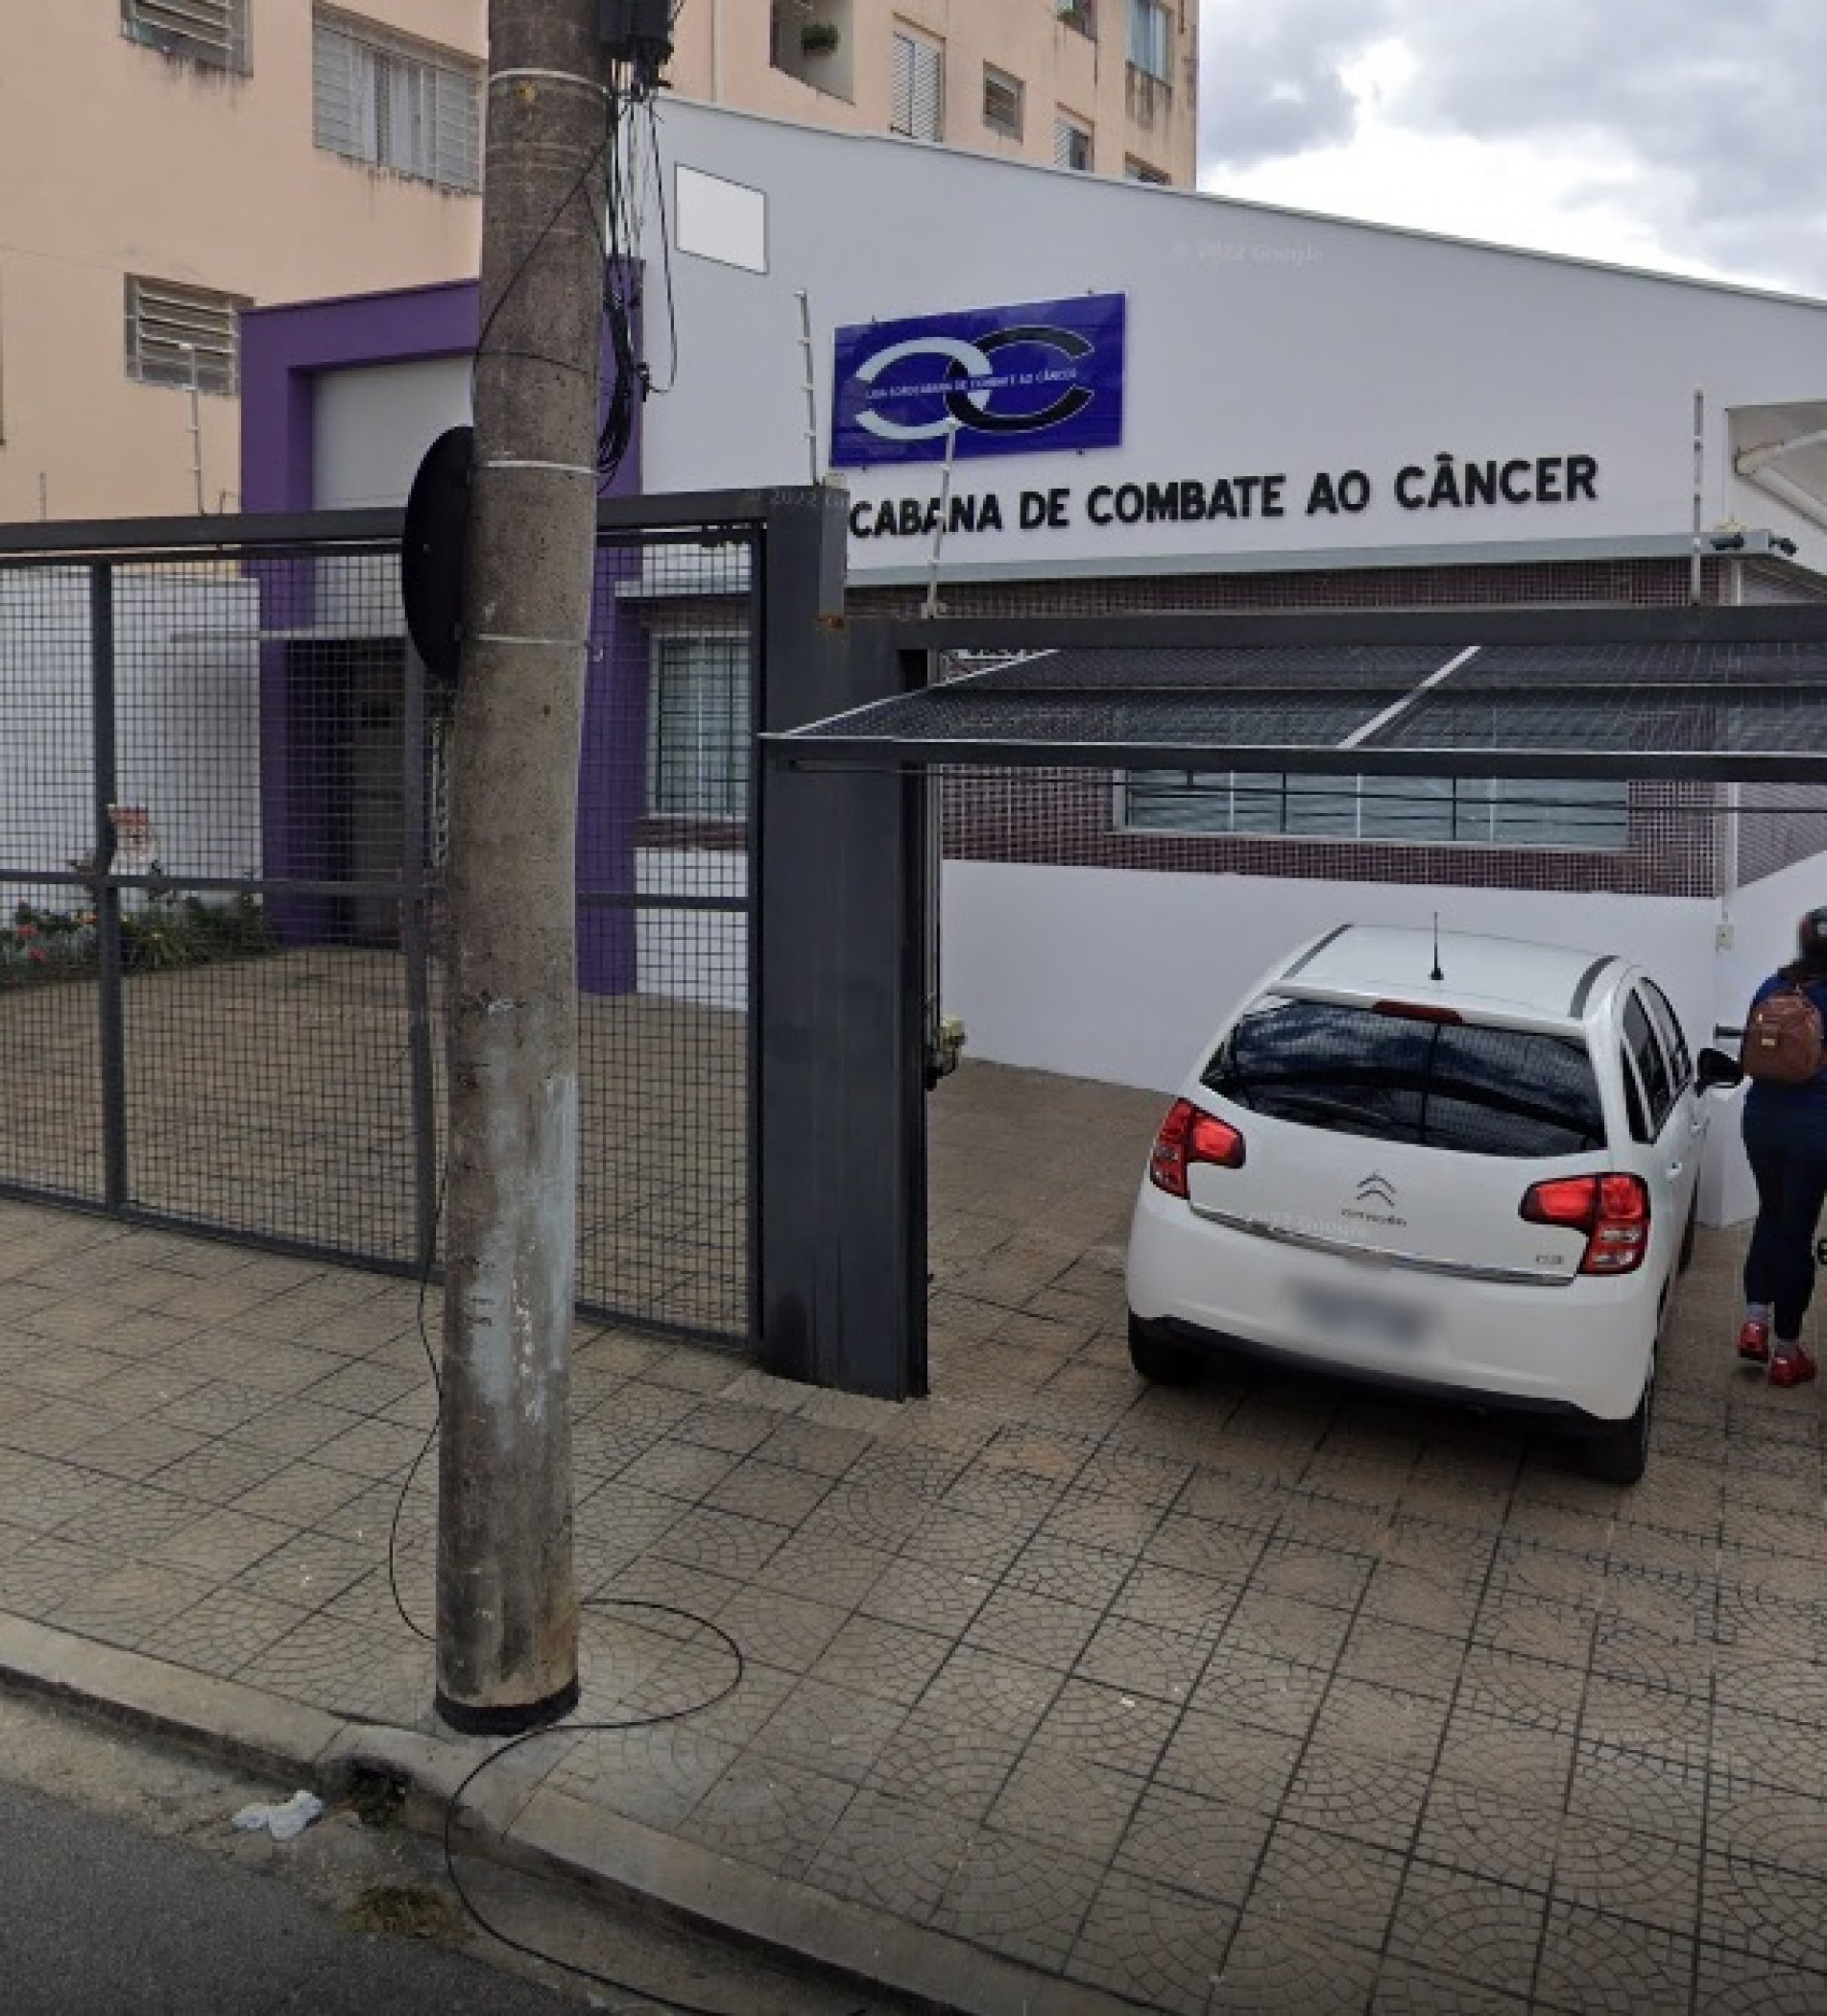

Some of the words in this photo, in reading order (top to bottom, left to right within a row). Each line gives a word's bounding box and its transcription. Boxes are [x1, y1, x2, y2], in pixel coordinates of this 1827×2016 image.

[849, 493, 1003, 539] CABANA
[1019, 488, 1070, 530] DE
[1087, 472, 1286, 525] COMBATE
[1305, 468, 1371, 514] AO
[1394, 451, 1599, 510] CÂNCER
